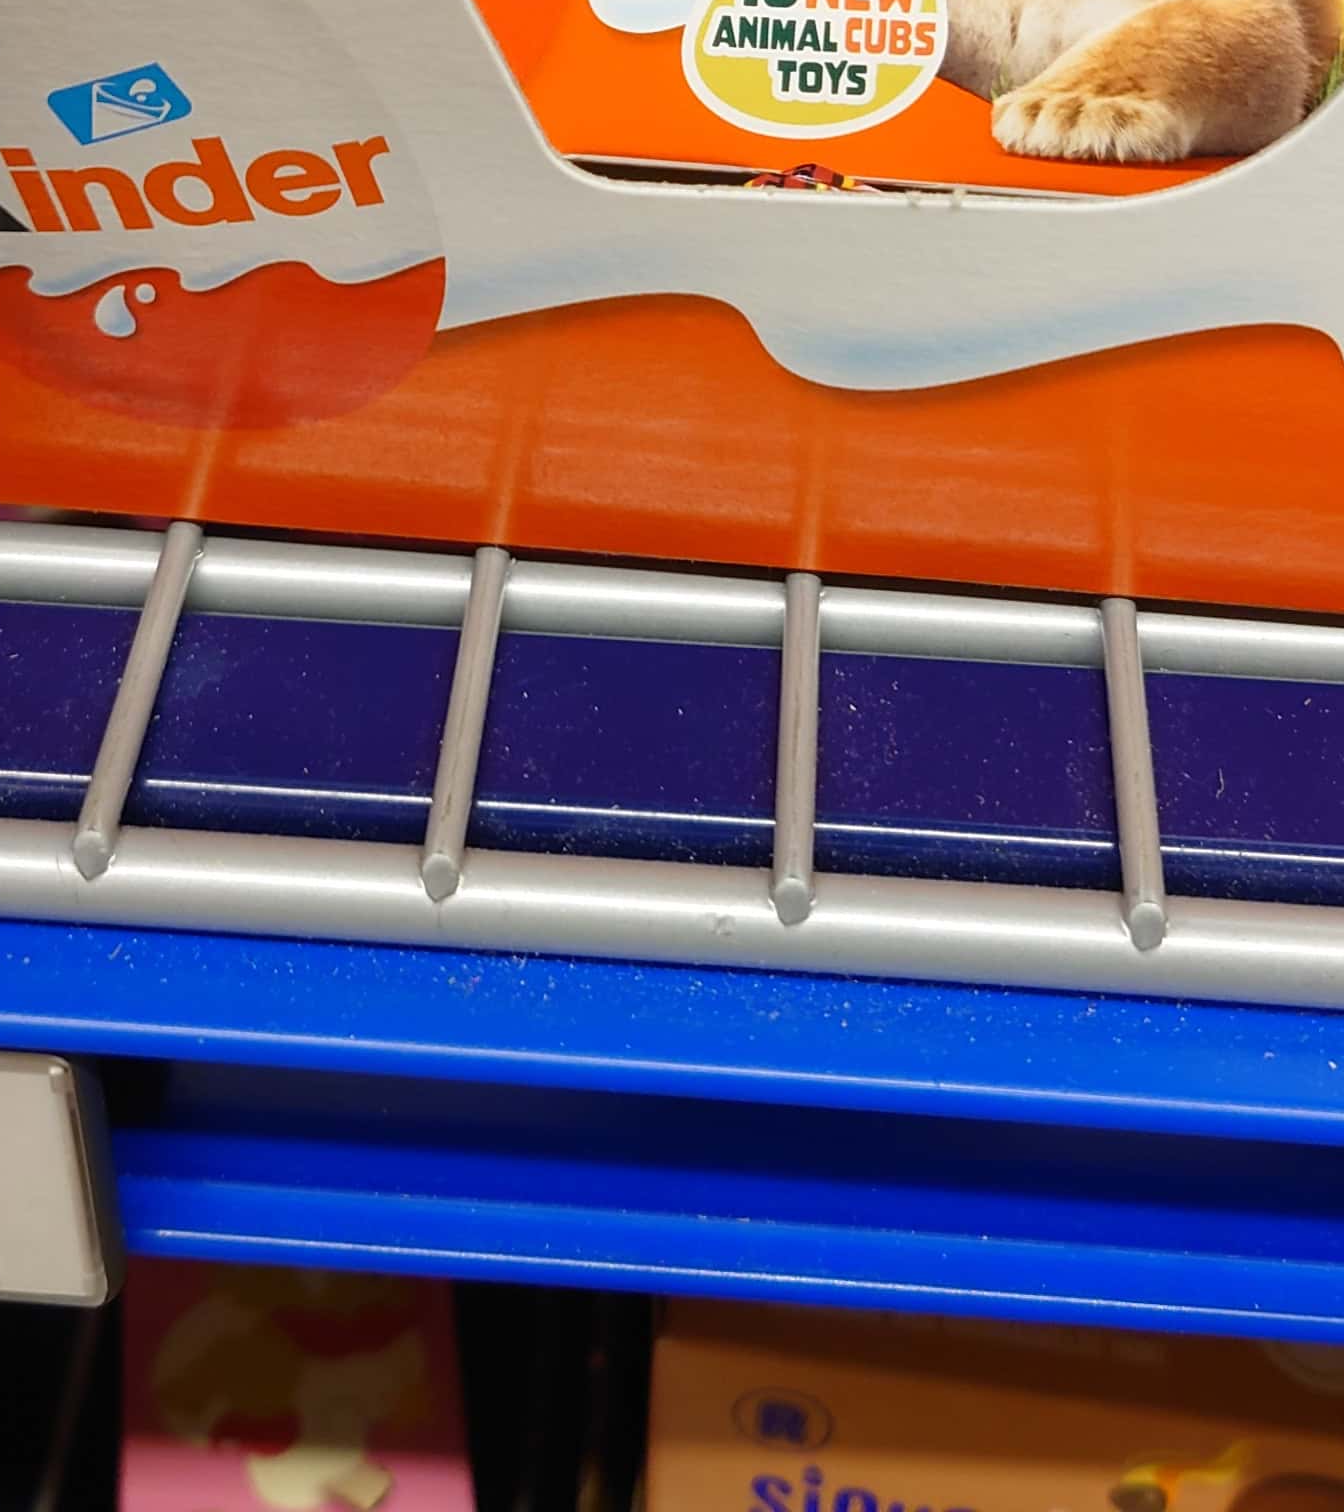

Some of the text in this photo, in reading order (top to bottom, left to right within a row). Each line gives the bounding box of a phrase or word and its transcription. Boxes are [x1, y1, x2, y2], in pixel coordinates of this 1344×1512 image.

[712, 15, 937, 56] ANIMAL CUBS
[776, 59, 868, 96] TOYS
